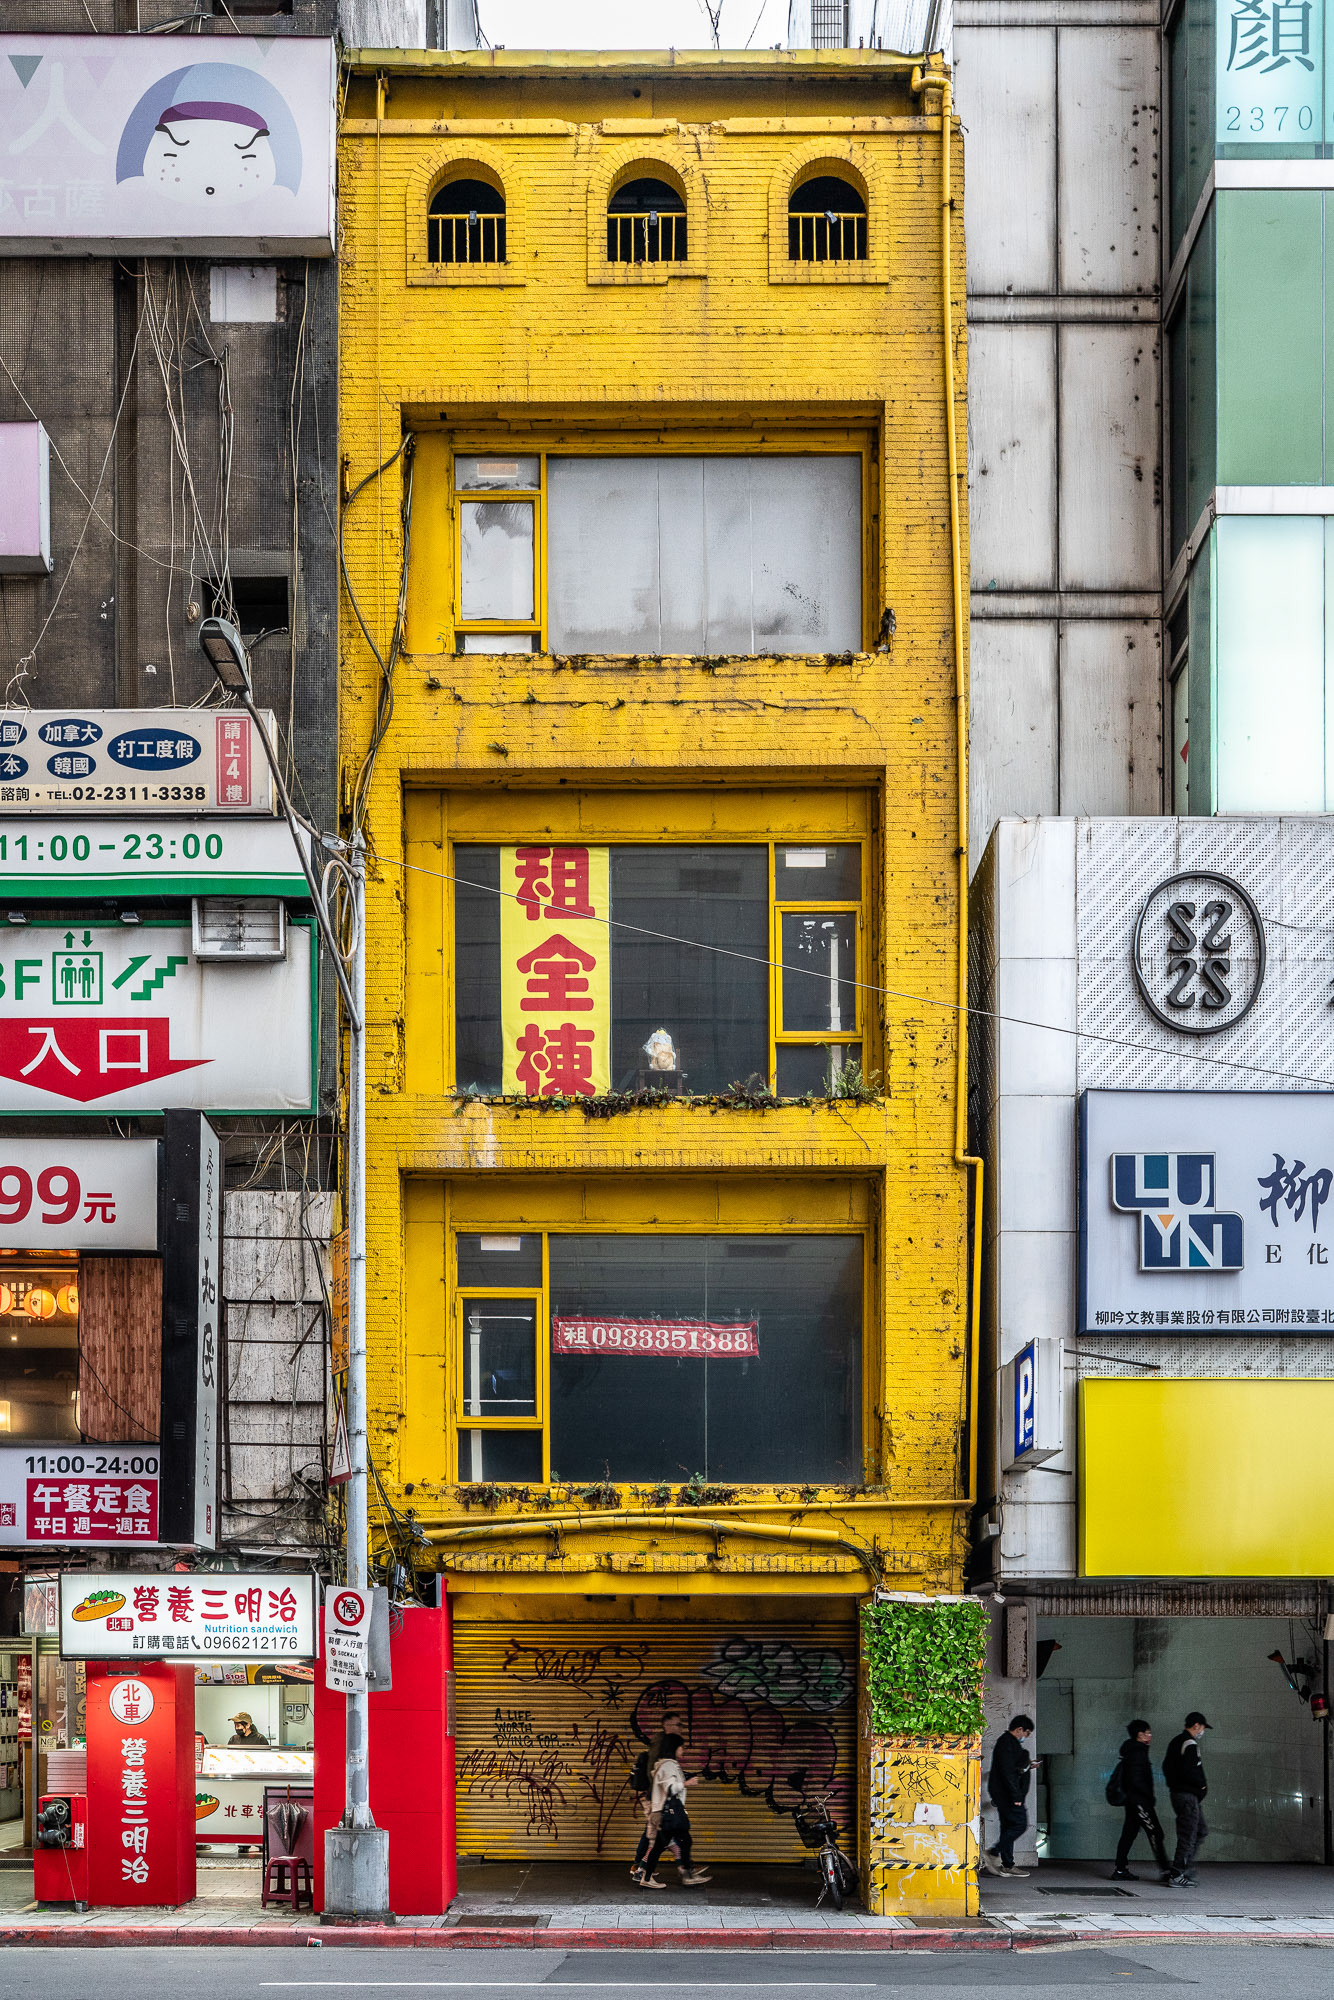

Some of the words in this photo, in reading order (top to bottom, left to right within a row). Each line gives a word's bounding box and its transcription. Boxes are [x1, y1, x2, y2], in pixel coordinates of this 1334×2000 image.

[45, 724, 98, 742] 加拿大
[117, 740, 194, 759] 打工度假
[54, 757, 89, 775] 韓國
[224, 722, 243, 802] 請上4樓
[515, 848, 597, 1096] 租全棟
[20, 1027, 148, 1077] 入口
[1019, 1356, 1033, 1446] P
[25, 1455, 159, 1475] 11:00-24:00
[33, 1483, 152, 1514] 午餐定食
[34, 1517, 67, 1535] 平日
[133, 1585, 297, 1623] 營養三明治
[342, 1599, 358, 1619] 停
[109, 1618, 133, 1631] 北車
[204, 1624, 248, 1633] Nutrition
[251, 1624, 298, 1633] sandwich
[132, 1635, 190, 1650] 訂購電話
[203, 1636, 298, 1650] 0966212176
[122, 1684, 141, 1721] 北車
[495, 1708, 503, 1721] A
[494, 1722, 534, 1734] WORTH
[120, 1737, 150, 1885] 營養三明治
